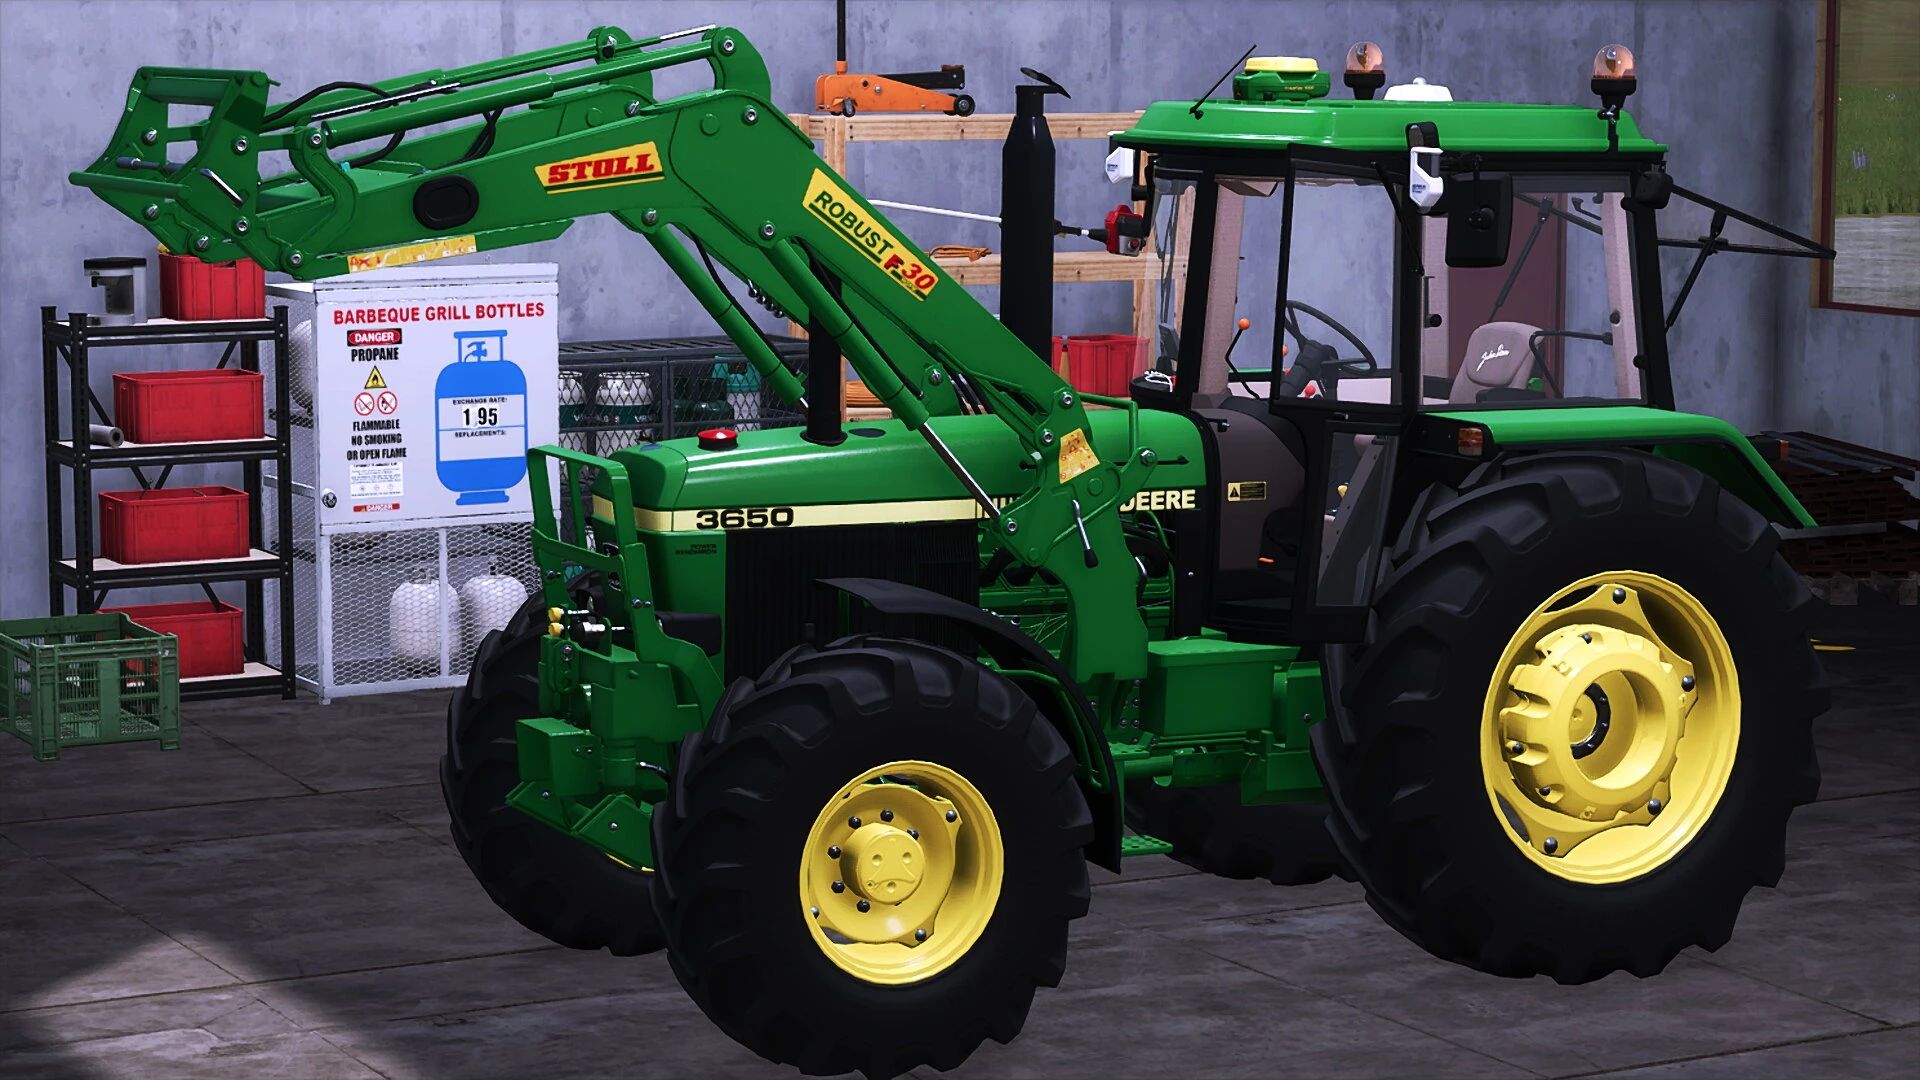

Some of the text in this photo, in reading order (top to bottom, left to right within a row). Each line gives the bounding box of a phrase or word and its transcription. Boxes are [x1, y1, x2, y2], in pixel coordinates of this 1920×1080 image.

[548, 153, 655, 184] STOLL
[814, 190, 894, 255] ROBUST
[333, 302, 545, 325] BARBEQUE GRILL BOTTLES
[354, 331, 394, 343] DANGER
[351, 347, 400, 362] PROPANE
[352, 418, 401, 432] FLAMMABLE
[351, 433, 402, 446] NO SMOKING
[346, 447, 408, 461] OR OPEN FLAME
[696, 507, 794, 530] 3650
